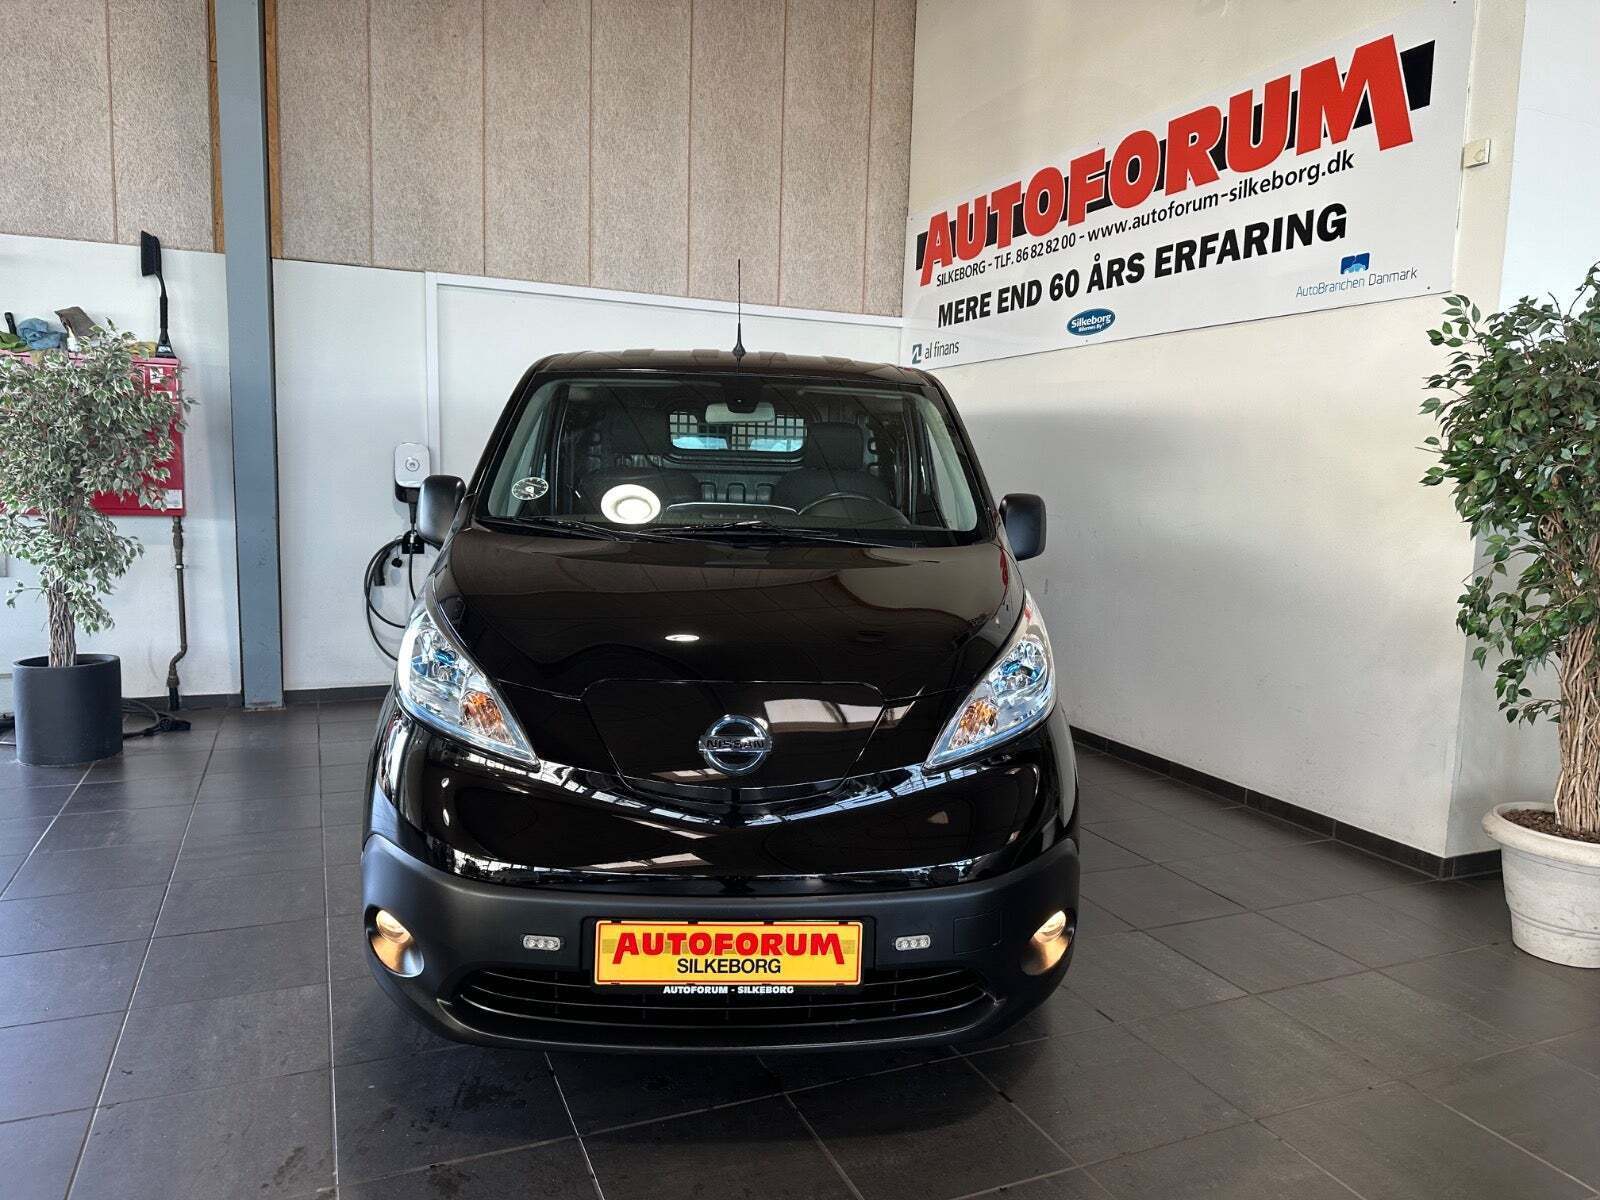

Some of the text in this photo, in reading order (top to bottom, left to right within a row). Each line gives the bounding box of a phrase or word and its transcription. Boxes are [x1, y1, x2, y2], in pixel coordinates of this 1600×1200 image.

[920, 34, 1413, 286] AUTOFORUM
[936, 260, 986, 287] SILKEBORG
[995, 252, 1014, 270] TLF.
[1088, 149, 1355, 242] www.autoforum-silkeborg.dk
[938, 202, 1347, 328] MERE END 60 ÅRS ERFARING
[1296, 267, 1418, 298] AutoBranchen Danmark
[1071, 314, 1112, 329] Silkeborg
[924, 340, 960, 360] al finans
[706, 739, 764, 748] NISSAN
[612, 932, 845, 964] AUTOFORUM
[676, 958, 781, 974] SILKEBORG
[663, 985, 729, 995] AUTOFORUM
[737, 985, 795, 995] SILKEBORG
